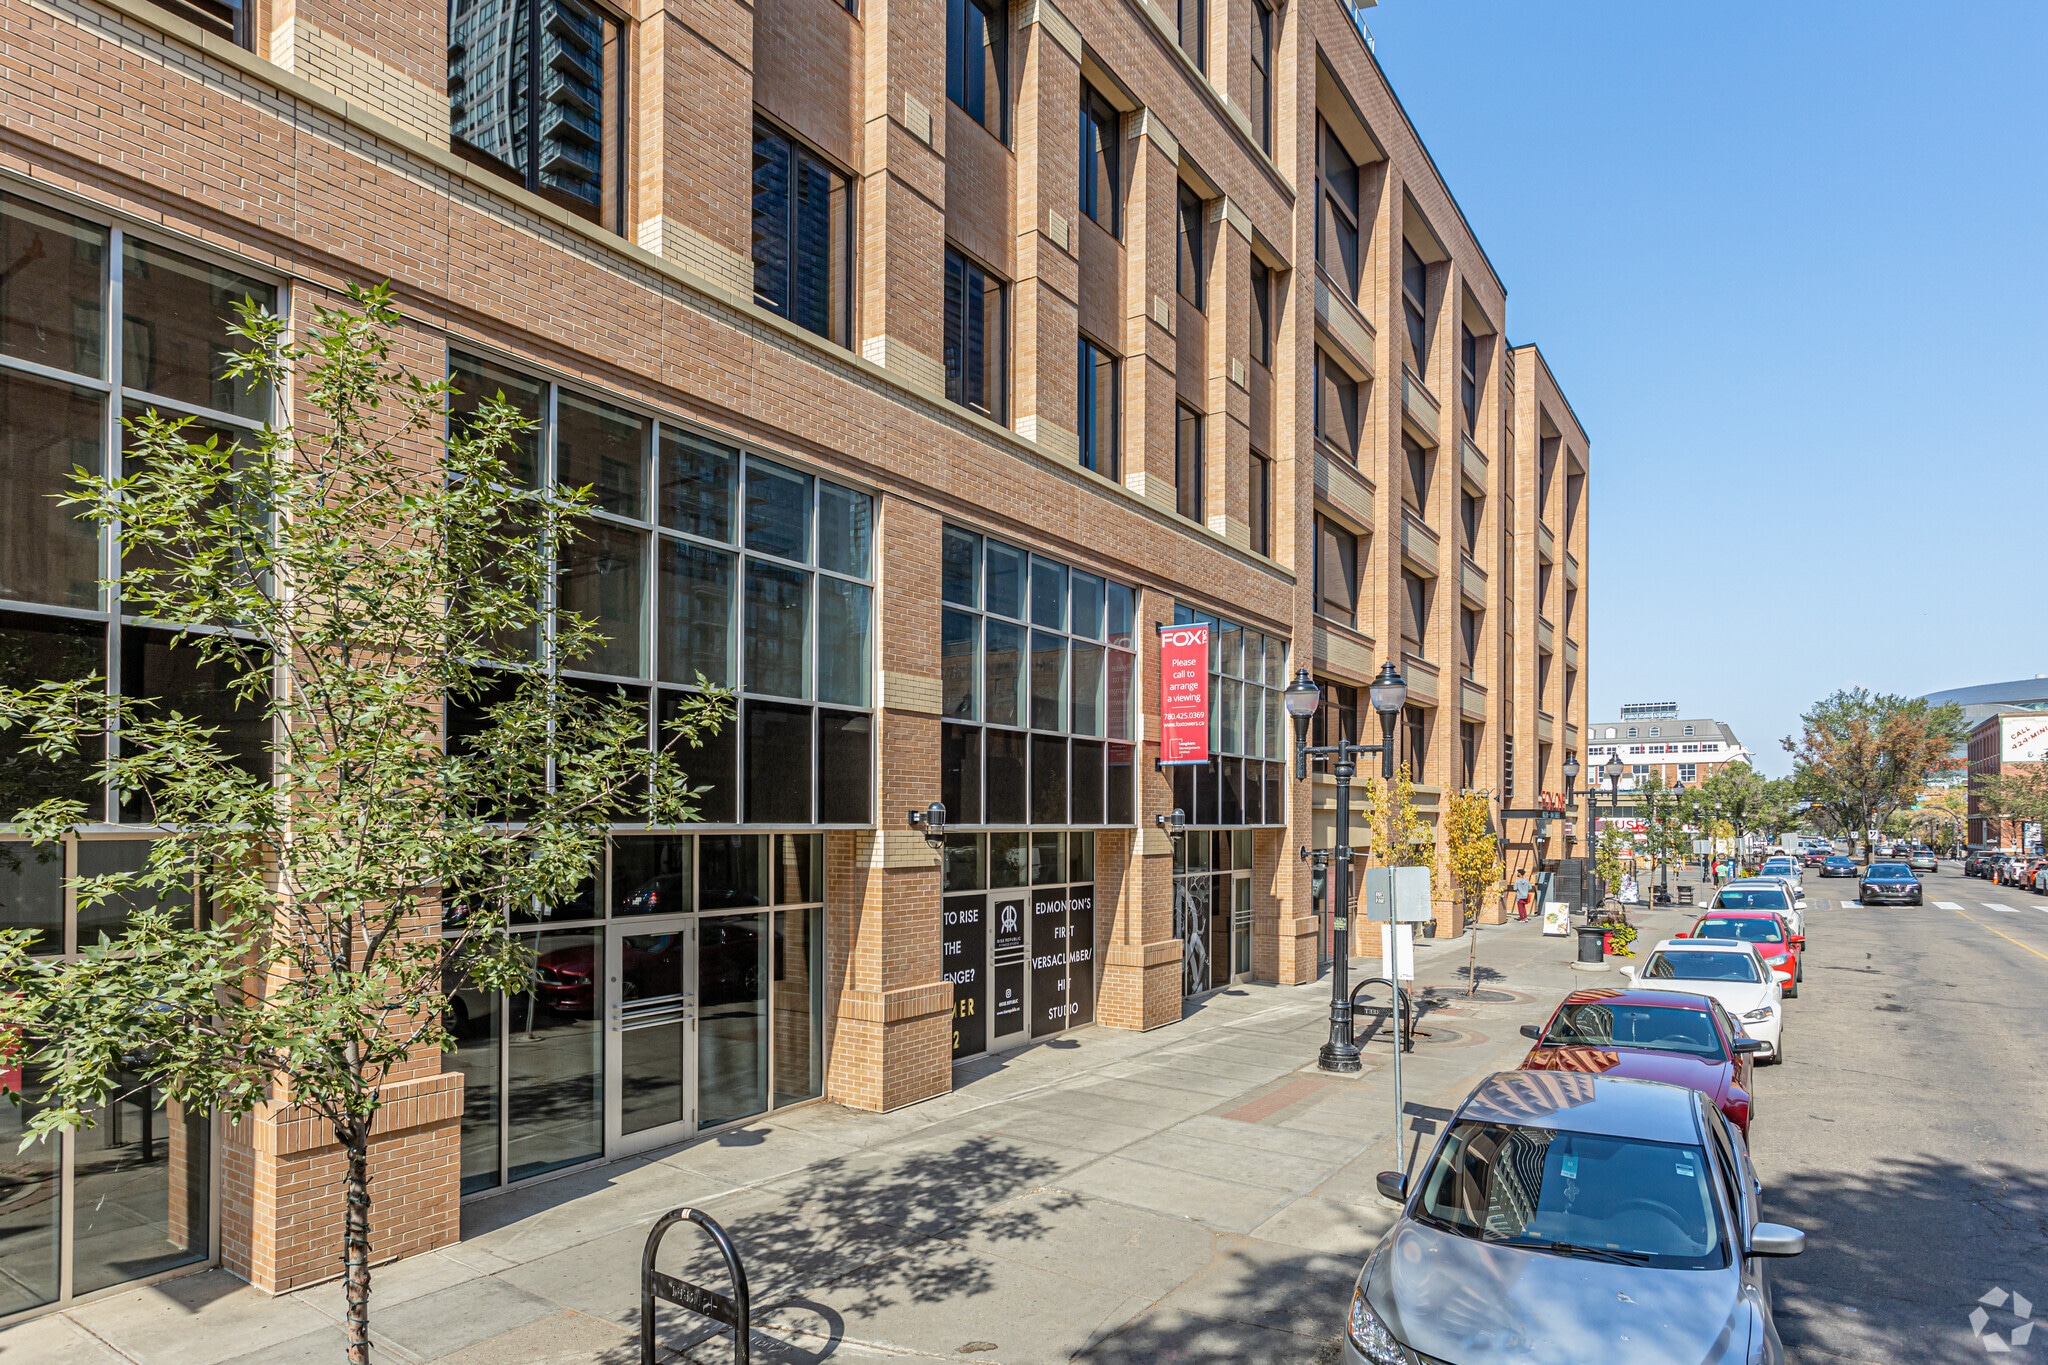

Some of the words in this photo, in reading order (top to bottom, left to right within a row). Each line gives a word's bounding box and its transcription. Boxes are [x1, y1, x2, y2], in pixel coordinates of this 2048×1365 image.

[1162, 630, 1202, 648] FOX
[1172, 658, 1197, 667] Please
[1173, 670, 1186, 679] call
[1187, 670, 1195, 678] to
[1169, 682, 1199, 691] arrange
[1173, 693, 1201, 703] viewing
[1163, 712, 1205, 720] 780.425.0369
[2010, 726, 2031, 740] CALL
[944, 911, 957, 925] TO
[959, 909, 979, 924] RISE
[1054, 925, 1075, 939] FIRT
[944, 940, 962, 956] THE
[1032, 948, 1092, 970] VERSACLMBER/
